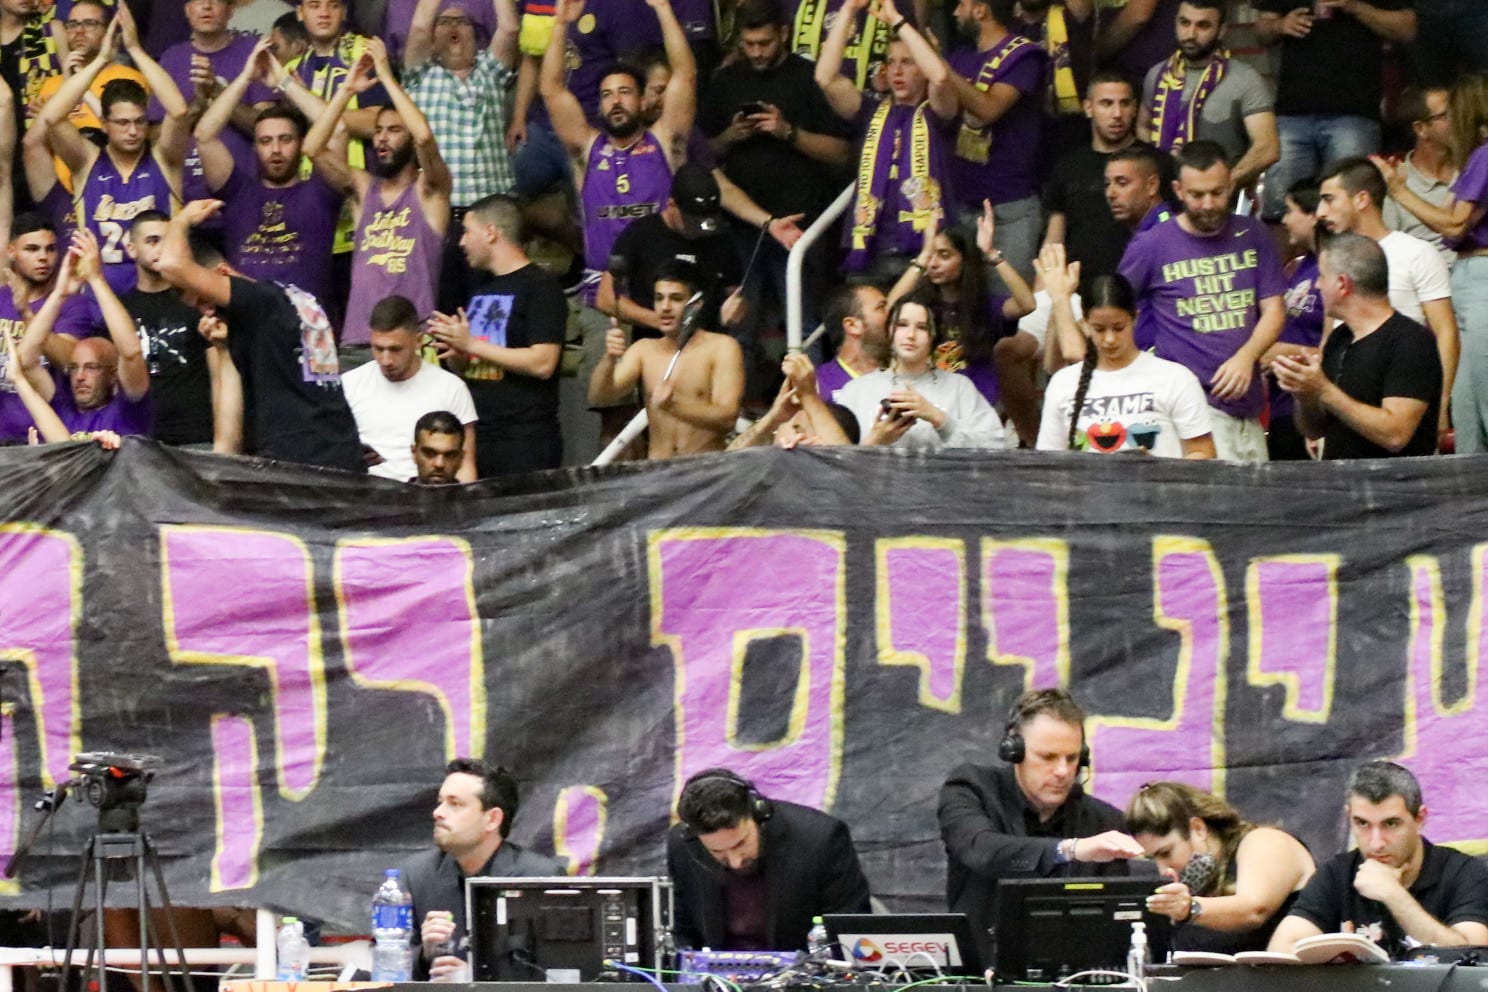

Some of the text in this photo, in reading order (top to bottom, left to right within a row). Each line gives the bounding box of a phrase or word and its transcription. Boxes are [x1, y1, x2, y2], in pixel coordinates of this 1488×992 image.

[914, 133, 926, 177] HAPOEL
[615, 173, 631, 195] 5
[1162, 249, 1258, 283] HUSTLE
[1194, 271, 1236, 295] HIT
[1176, 289, 1256, 317] NEVER
[1193, 309, 1248, 333] QUIT
[159, 521, 488, 894] רק
[883, 940, 949, 954] SEGEV
